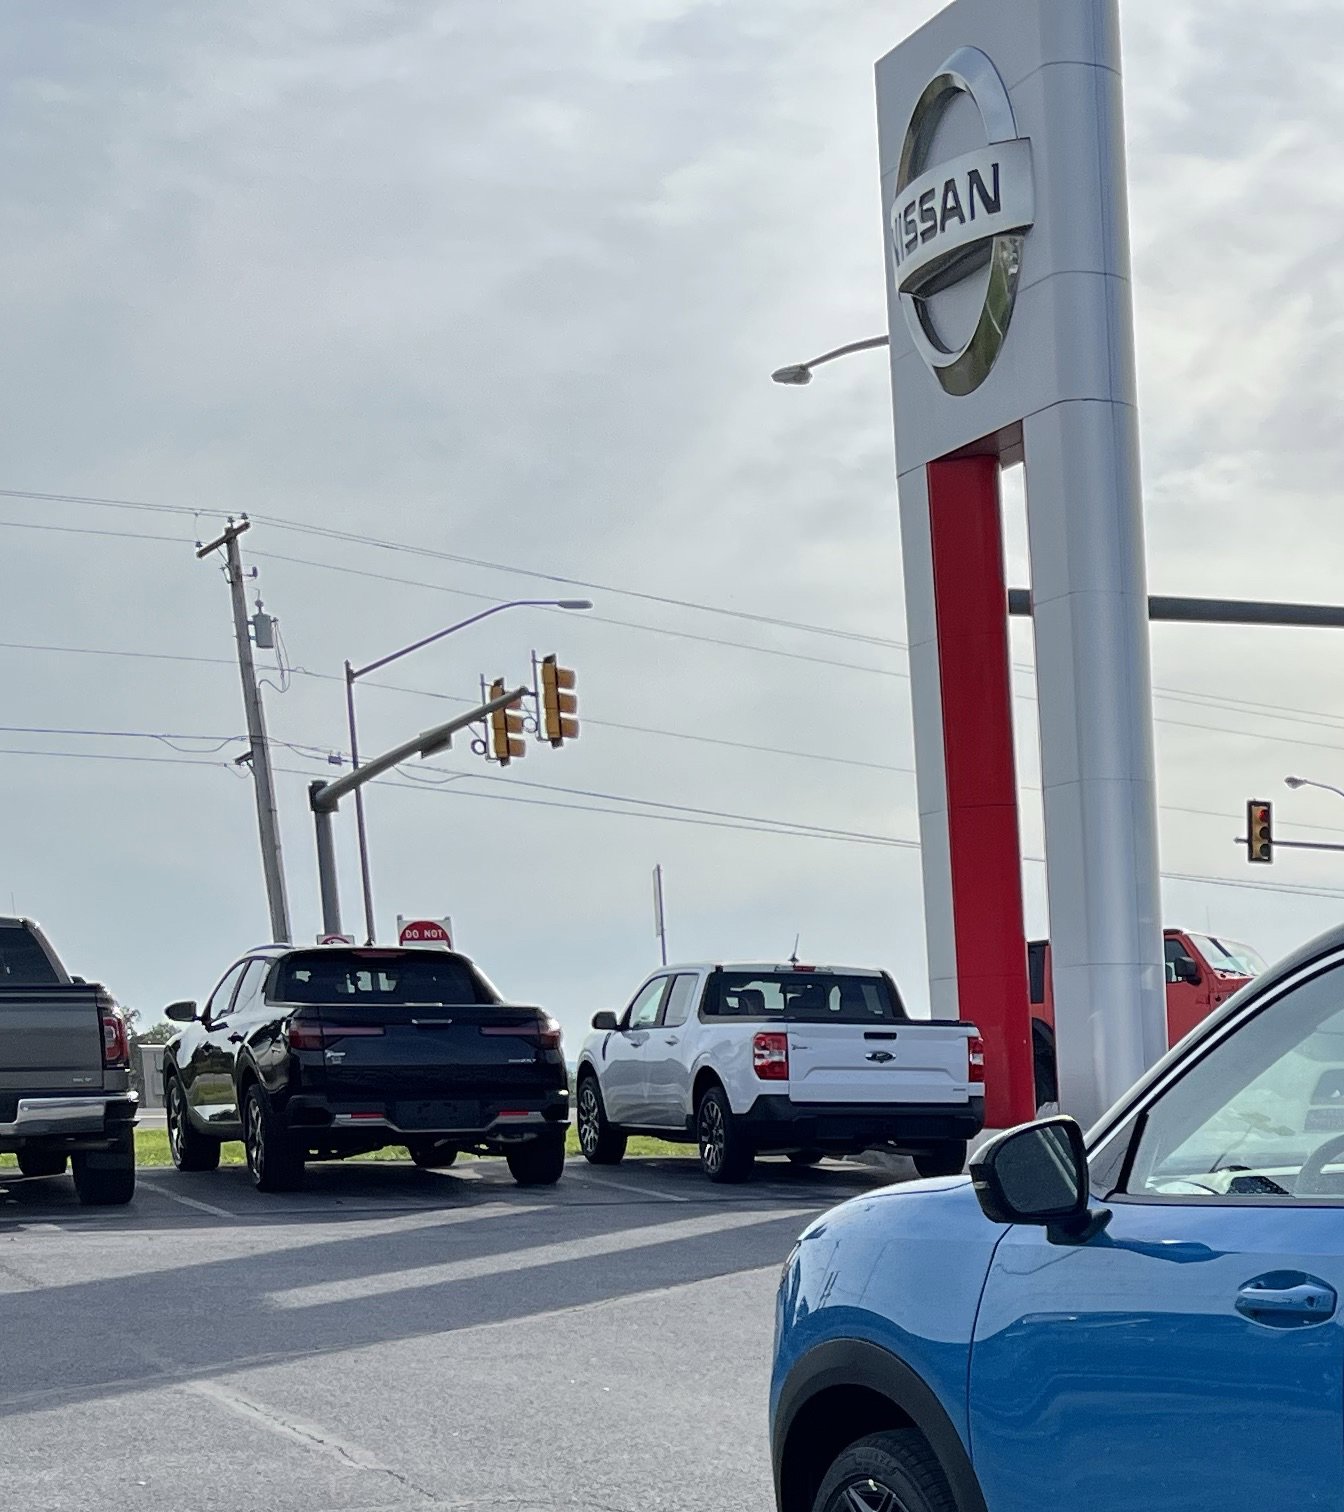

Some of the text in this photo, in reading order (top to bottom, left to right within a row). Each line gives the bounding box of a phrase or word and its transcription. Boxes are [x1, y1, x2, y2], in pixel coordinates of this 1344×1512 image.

[892, 162, 1001, 267] NISSAN
[405, 929, 443, 938] DO NOT
